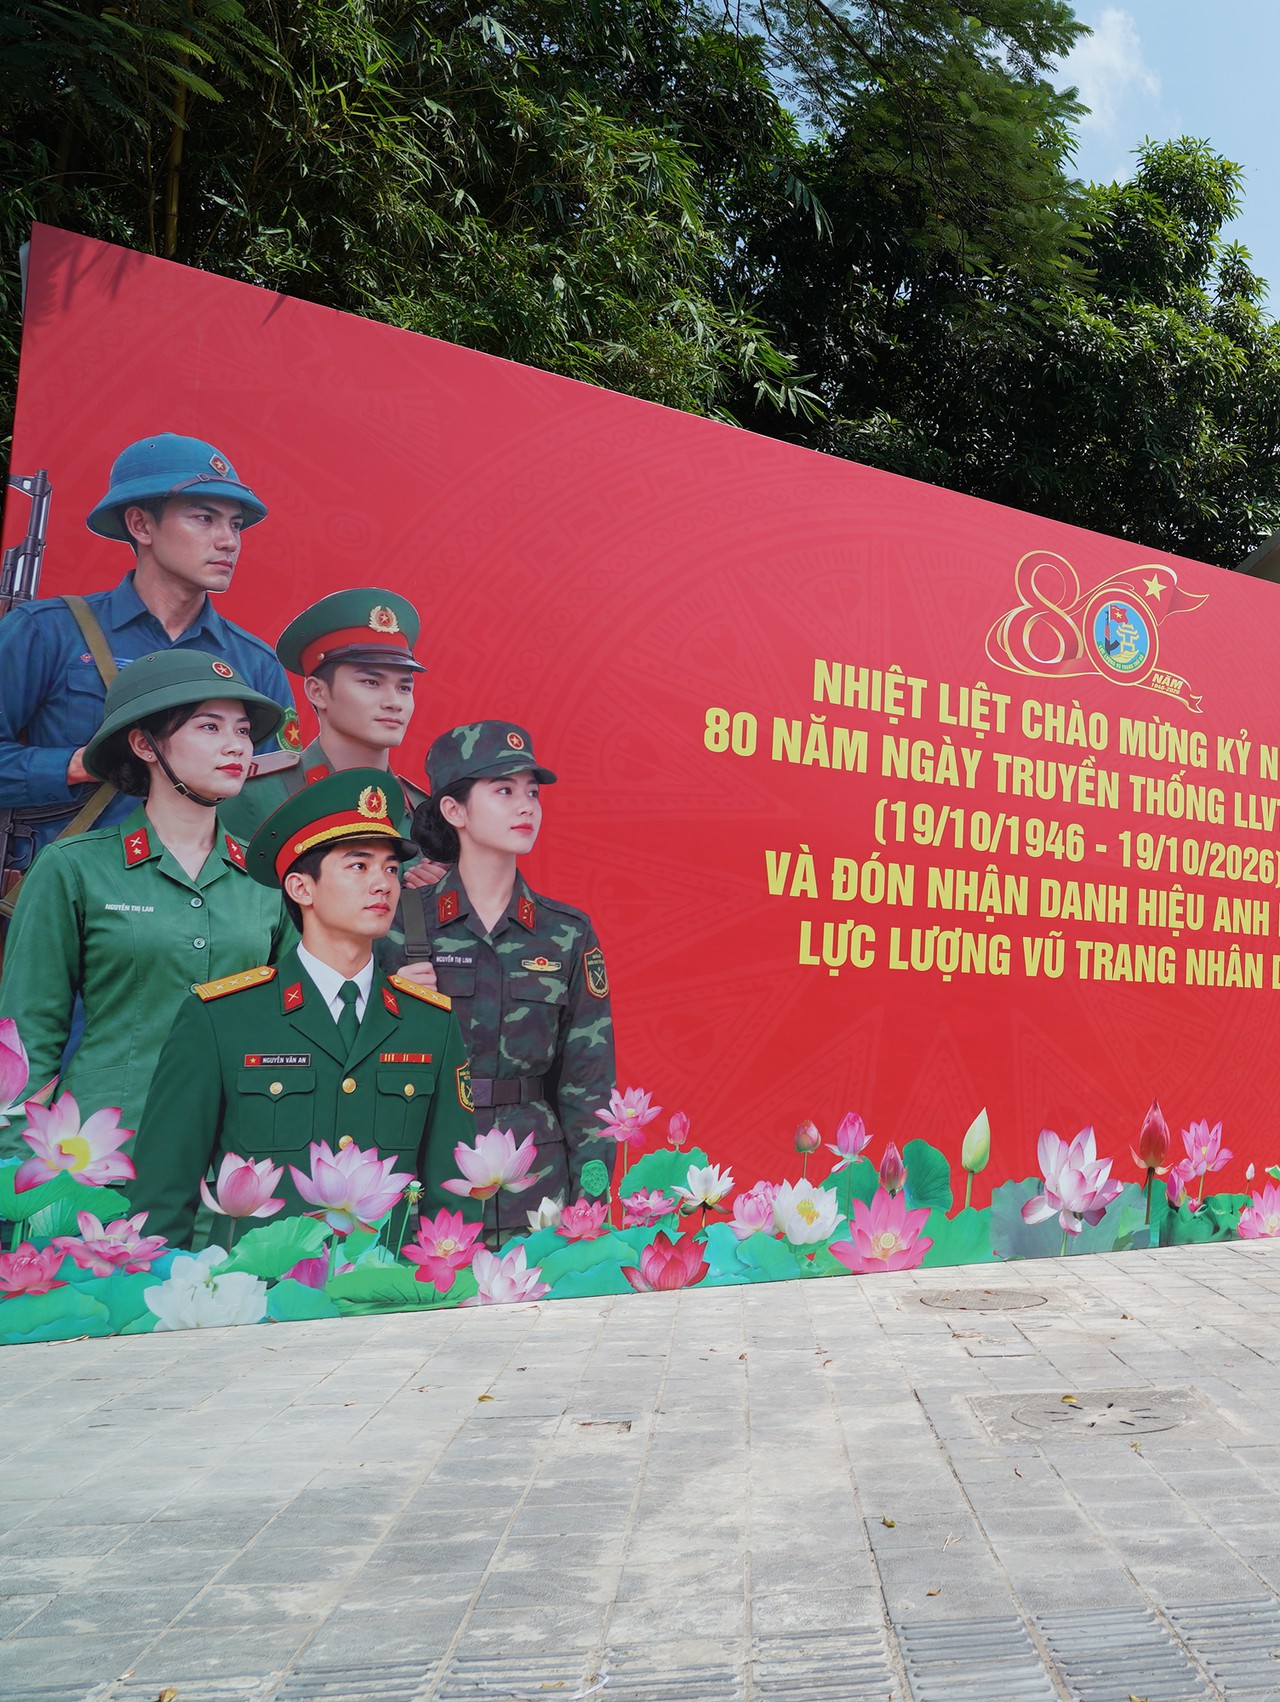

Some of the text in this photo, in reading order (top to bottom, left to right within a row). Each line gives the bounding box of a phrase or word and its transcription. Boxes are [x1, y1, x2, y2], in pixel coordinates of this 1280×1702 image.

[814, 659, 927, 724] NHIỆT
[939, 682, 1011, 738] LIỆT
[1022, 700, 1108, 750] CHÀO
[1120, 715, 1207, 768] MỪNG
[1218, 729, 1251, 775] KỶ
[1152, 673, 1183, 690] NĂM
[704, 708, 757, 756] 80
[772, 714, 868, 773] NĂM
[882, 735, 982, 788] NGÀY
[993, 753, 1119, 809] TRUYỀN
[1130, 770, 1224, 824] THỐNG
[875, 799, 1084, 861] (19/10/1946
[1096, 844, 1106, 852] -
[766, 844, 817, 898] VÀ
[832, 852, 914, 906] ĐÓN
[928, 864, 1028, 922] NHẬN
[1040, 879, 1127, 923] DANH
[1138, 884, 1204, 937] HIỆU
[1213, 897, 1269, 935] ANH
[800, 920, 875, 976] LỰC
[890, 926, 1010, 982] LƯỢNG
[1023, 931, 1064, 978] VŨ
[1076, 941, 1175, 983] TRANG
[1186, 944, 1263, 988] NHÂN
